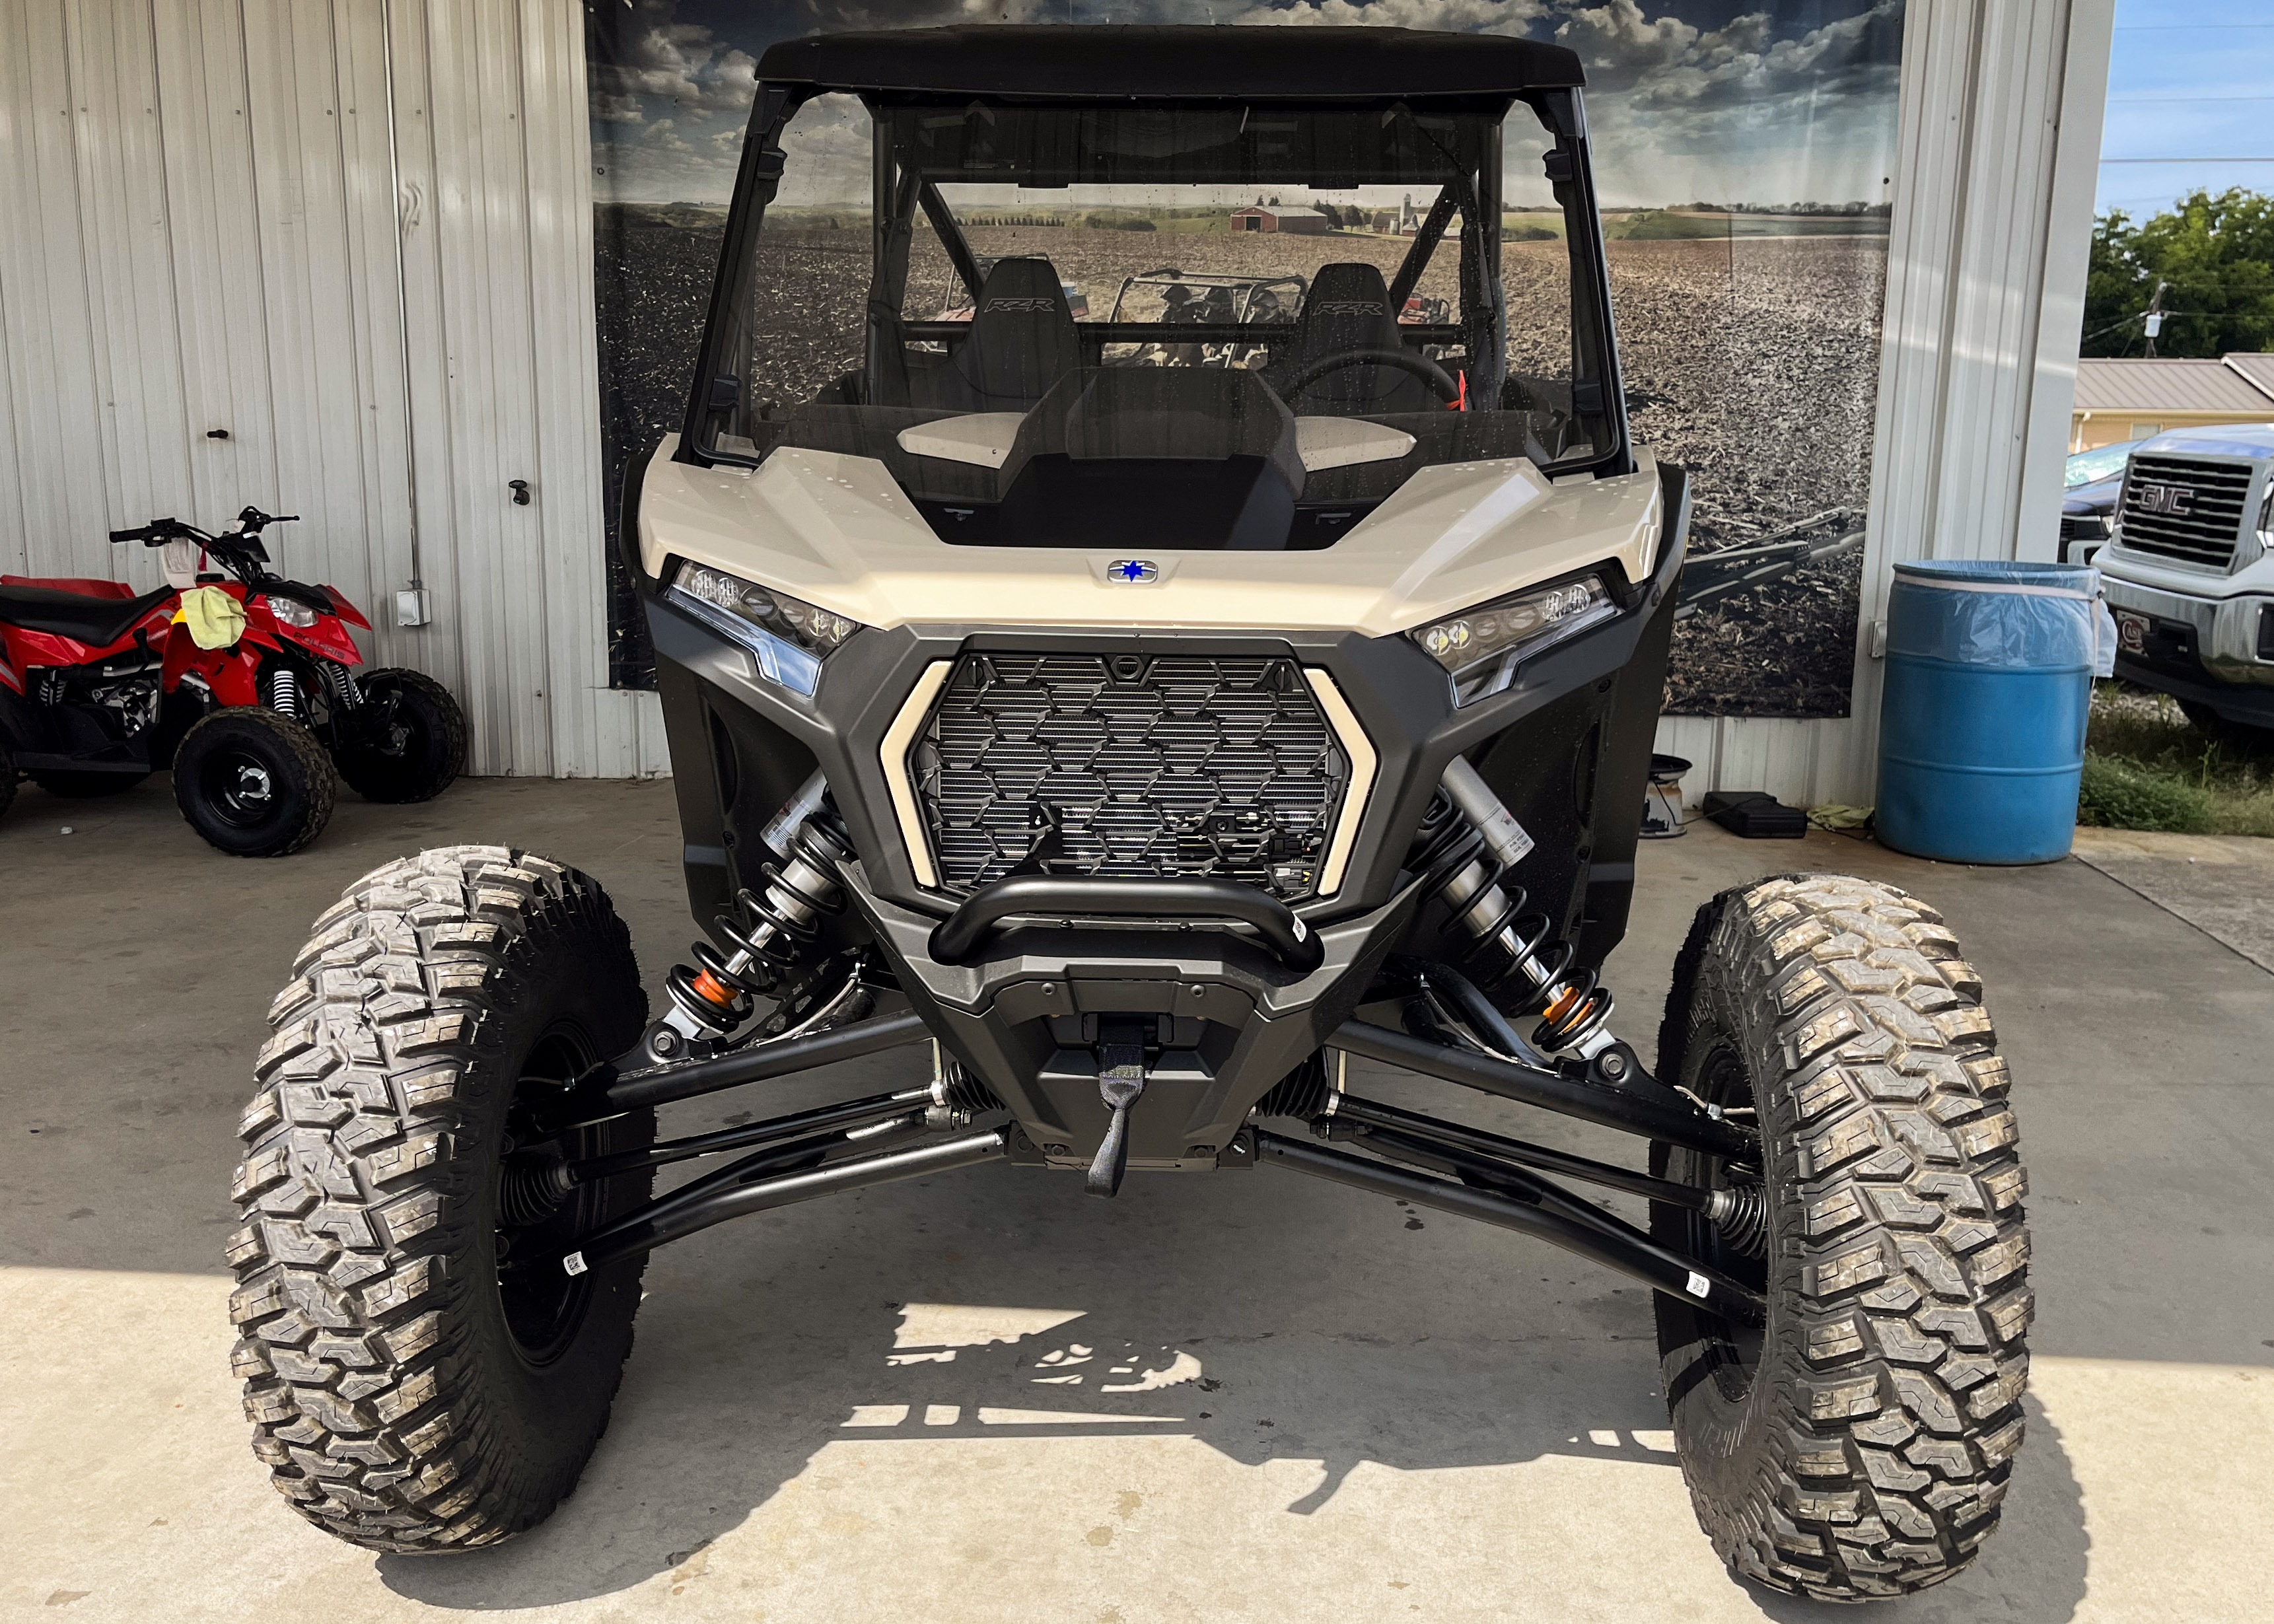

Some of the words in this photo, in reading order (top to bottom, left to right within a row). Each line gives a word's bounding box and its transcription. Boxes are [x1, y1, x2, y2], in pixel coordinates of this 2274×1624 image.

[983, 298, 1055, 313] RZR
[1312, 301, 1383, 316] RZR
[2139, 484, 2194, 515] GMC
[293, 631, 345, 660] POLARIS
